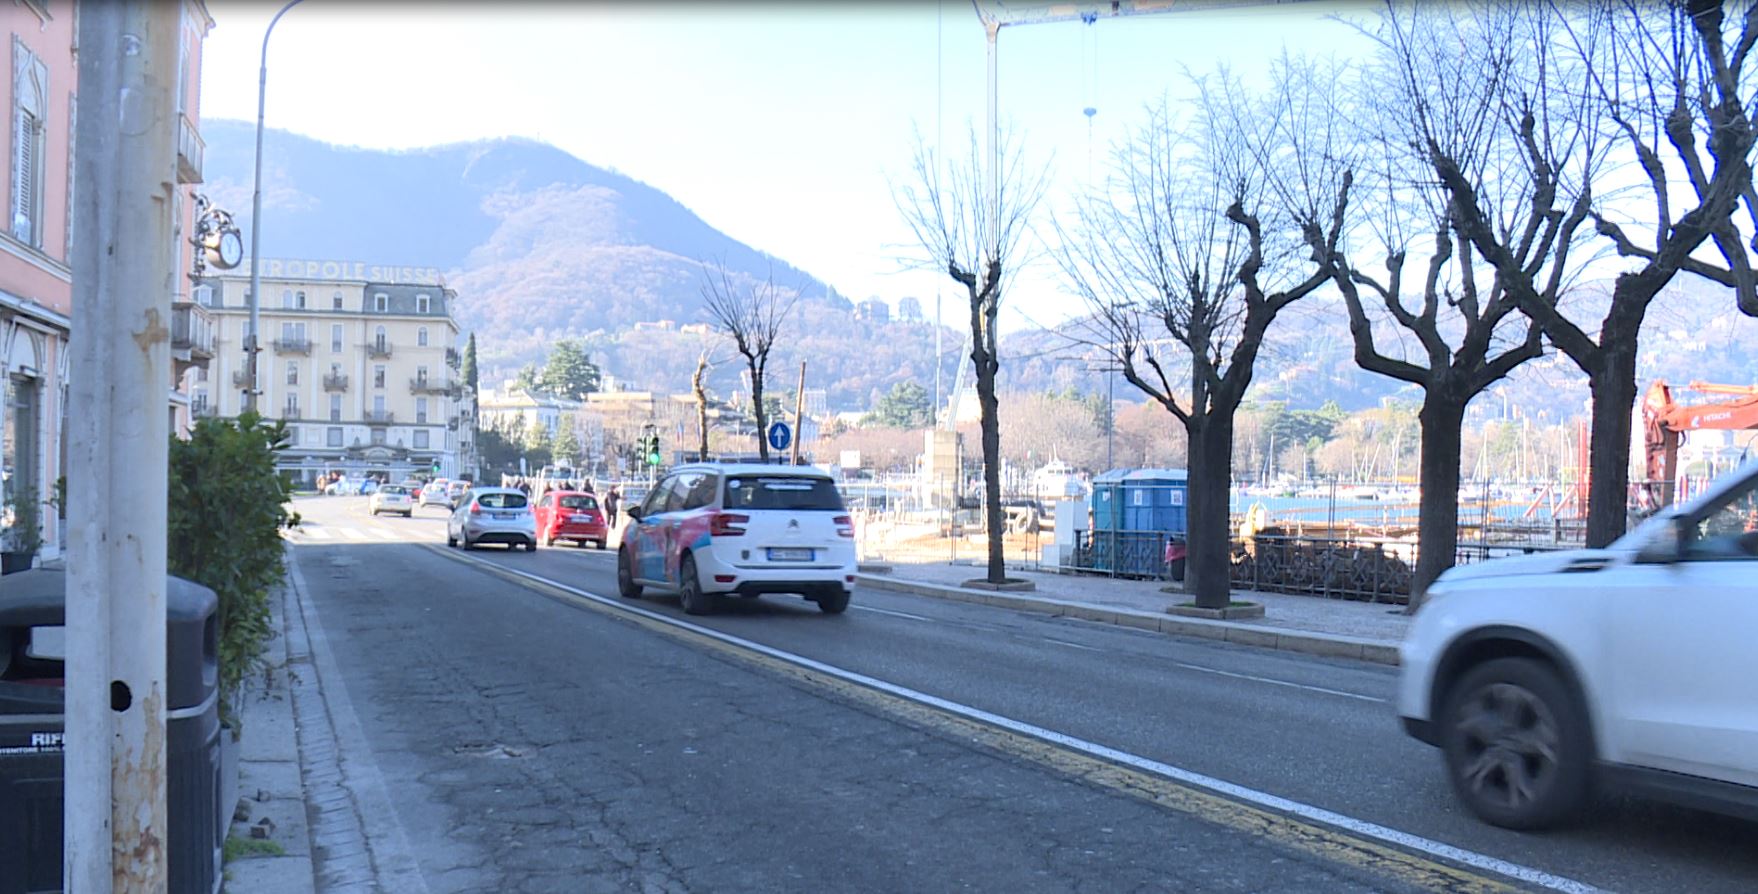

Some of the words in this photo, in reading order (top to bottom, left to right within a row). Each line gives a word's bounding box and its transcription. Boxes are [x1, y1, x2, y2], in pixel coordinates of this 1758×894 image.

[230, 258, 366, 281] ETROPOLE
[371, 265, 438, 284] SUISSE
[1703, 411, 1732, 423] HITACHI
